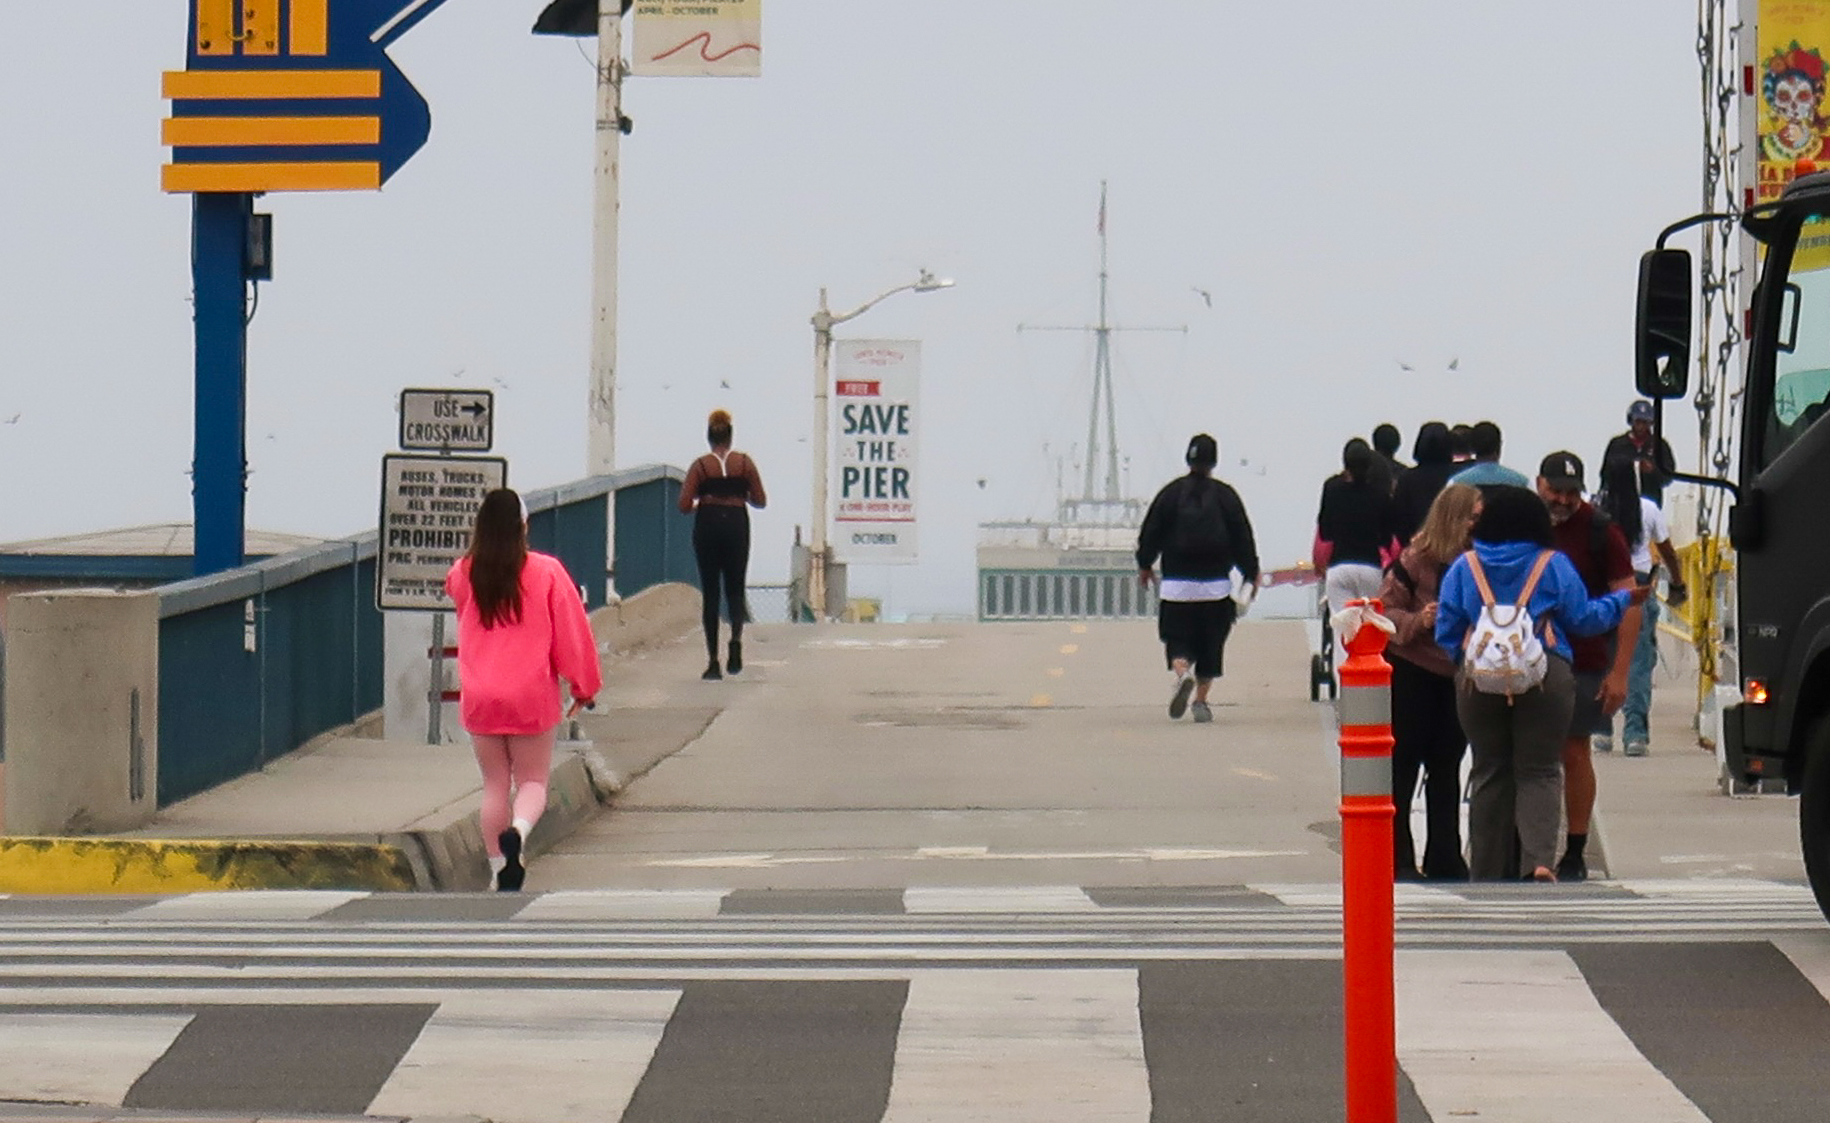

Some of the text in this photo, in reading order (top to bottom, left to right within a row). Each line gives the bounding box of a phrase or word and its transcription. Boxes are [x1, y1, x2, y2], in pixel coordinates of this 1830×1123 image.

[672, 7, 719, 15] OCTOBER
[434, 400, 459, 418] USE
[844, 404, 909, 435] SAVE
[406, 423, 485, 442] CROSSWALK
[857, 441, 895, 461] THE
[843, 467, 910, 499] PIER
[408, 500, 479, 513] ALL VEHICLES
[390, 514, 416, 525] OVER
[421, 515, 435, 526] 22
[440, 515, 464, 527] FEET
[389, 530, 470, 549] PROHIBIT
[852, 533, 896, 544] OCTOBER
